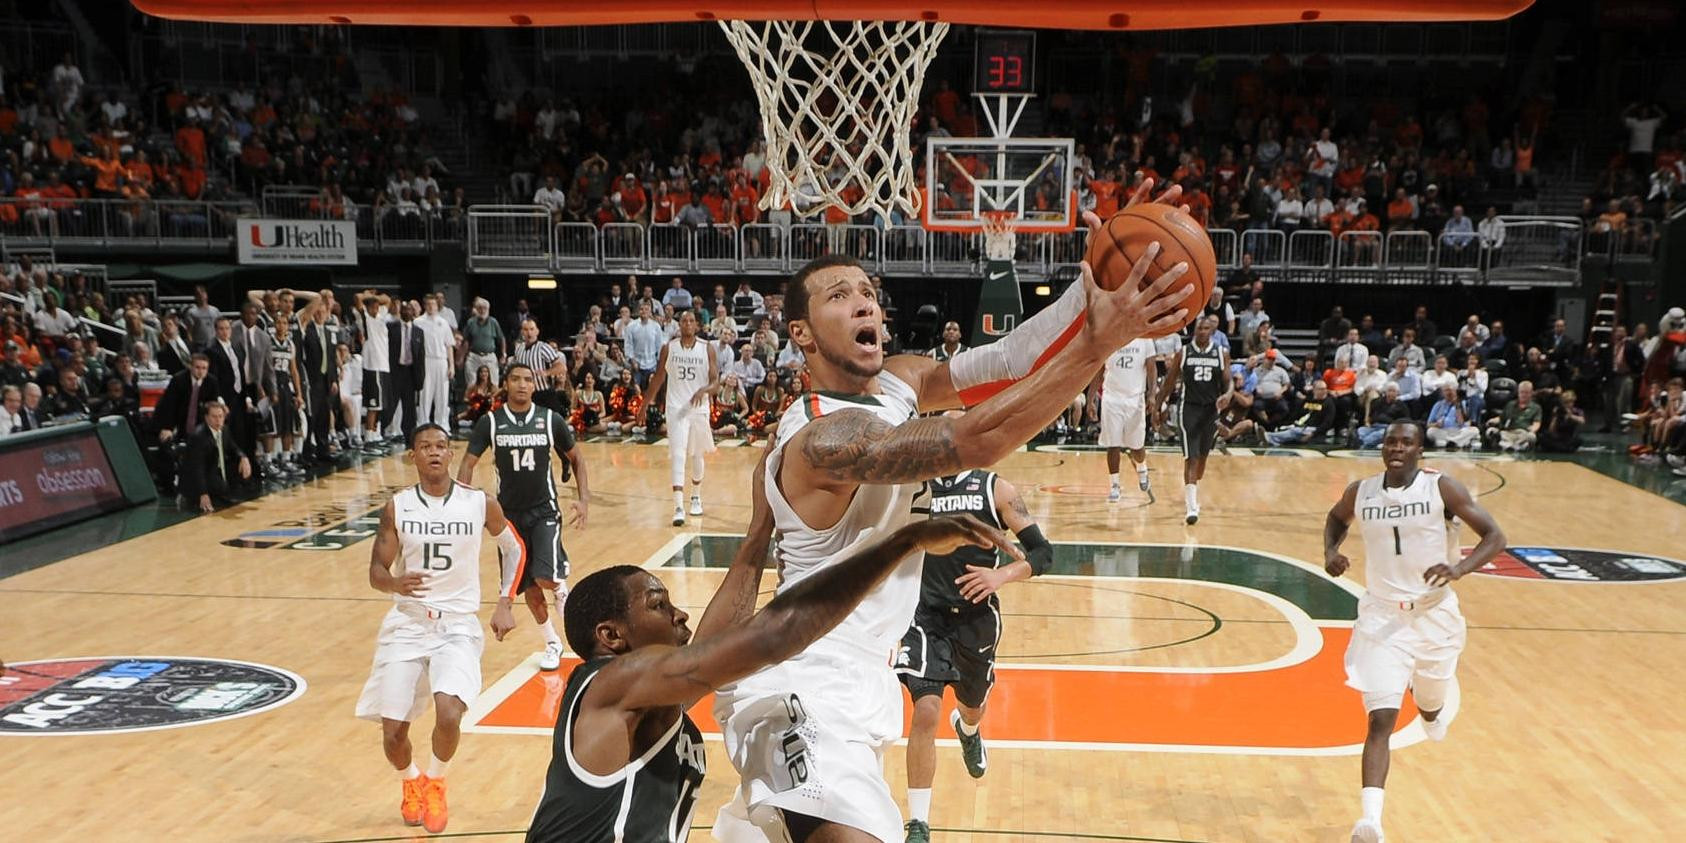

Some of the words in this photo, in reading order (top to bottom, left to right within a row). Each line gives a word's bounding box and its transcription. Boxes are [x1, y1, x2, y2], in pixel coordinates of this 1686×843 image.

[989, 56, 1022, 86] 33
[250, 224, 344, 248] UHealth
[1115, 356, 1134, 368] 42
[678, 366, 696, 380] 35
[1194, 366, 1212, 381] 25
[496, 433, 547, 447] SPARTANS
[510, 448, 536, 471] 14
[931, 494, 984, 512] ARTANS
[1362, 501, 1430, 520] miami
[401, 520, 473, 536] miami
[1393, 526, 1402, 556] 1
[423, 542, 453, 571] 15
[2, 693, 104, 728] ACC
